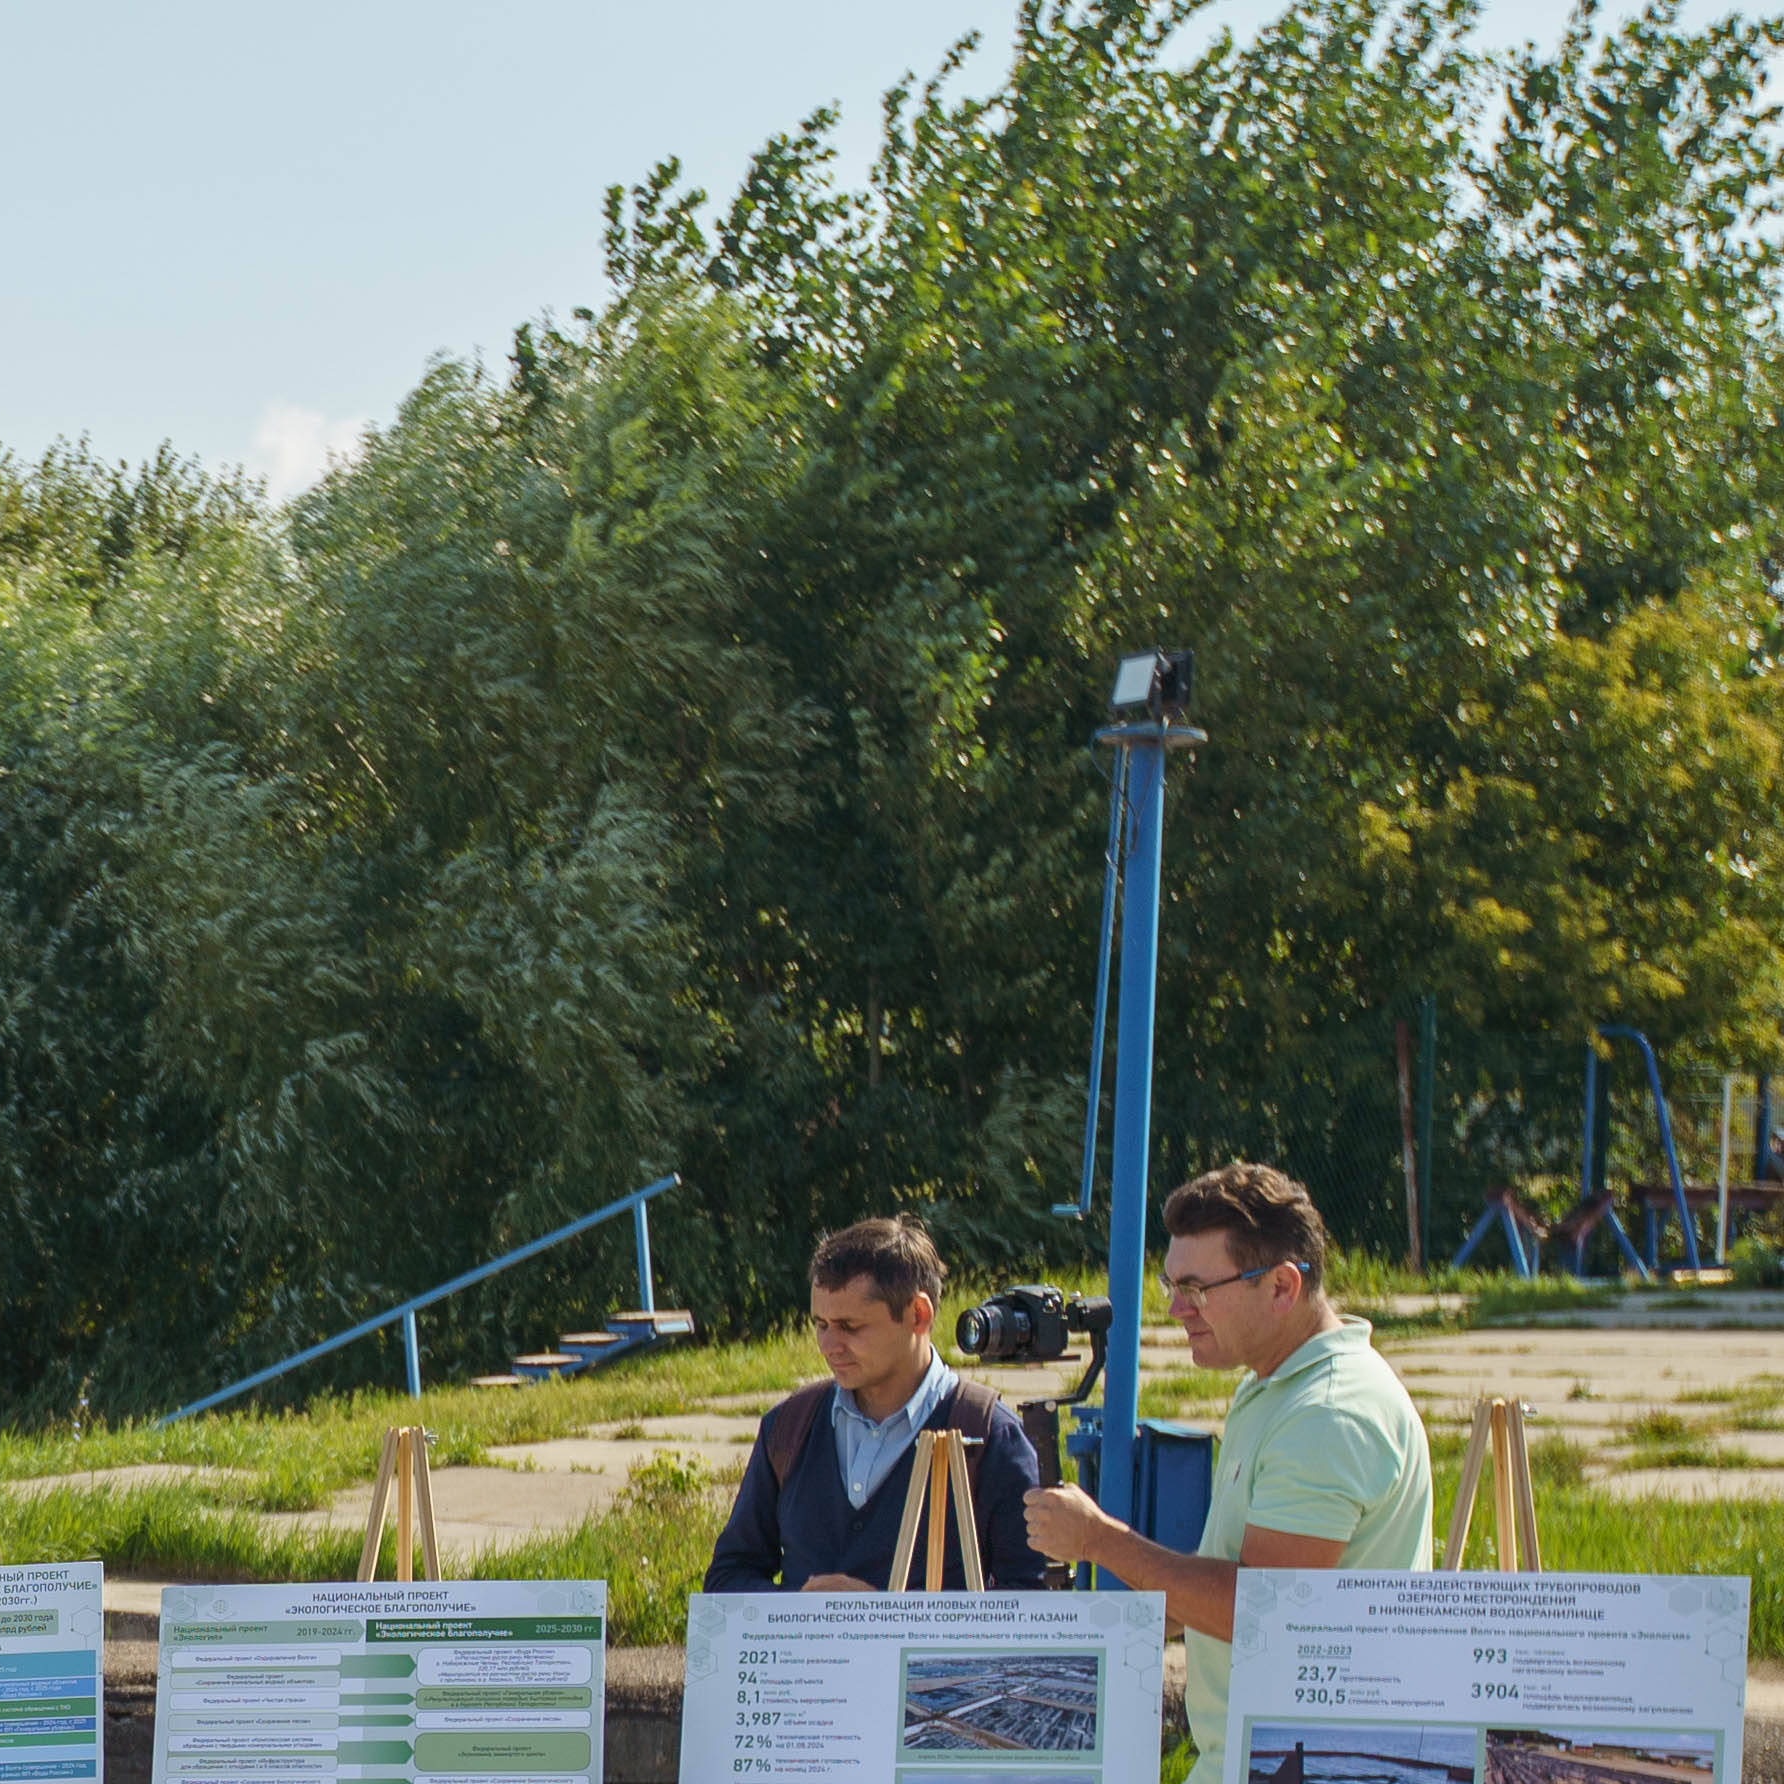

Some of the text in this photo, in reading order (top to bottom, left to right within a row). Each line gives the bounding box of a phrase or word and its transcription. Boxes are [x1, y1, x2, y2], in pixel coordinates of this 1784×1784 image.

[27, 1570, 70, 1581] ПРОЕКТ
[3, 1580, 98, 1594] БЛАГОПОЛУЧИЕ»
[1336, 1578, 1641, 1595] ДЕМОНТАЖ БЕЗДЕЙСТВУЮЩИХ ТРУБОПРОВОДОВ
[312, 1591, 450, 1601] НАЦИОНАЛЬНЫЙ ПРОЕКТ
[1397, 1593, 1577, 1606] ОЗЕРНОГО МЕСТОРОЖДЕНИЯ
[285, 1603, 477, 1613] «ЭКОЛОГИЧЕСКОЕ БЛАГОПОЛУЧИЕ»
[825, 1598, 1020, 1611] РЕКУЛЬТИВАЦИЯ ИЛОВЫХ ПОЛЕЙ
[0, 1616, 12, 1625] до
[13, 1614, 33, 1623] 2030
[34, 1614, 54, 1623] года
[767, 1612, 1079, 1623] БИОЛОГИЧЕСКИХ ОЧИСТНЫХ СООРУЖЕНИЙ Г. КАЗАНИ
[1368, 1606, 1605, 1622] В НИЖНЕКАМСКОМ ВОДОХРАНИЛИЩЕ
[18, 1623, 47, 1634] рублей
[173, 1624, 268, 1634] Национальный проект
[375, 1621, 473, 1630] Национальный проект
[535, 1624, 583, 1634] 2025-2030
[173, 1633, 224, 1642] «Экология»
[296, 1627, 343, 1637] 2019-2024
[375, 1629, 513, 1639] «Экологическое благополучие»
[741, 1631, 1105, 1642] Федеральный проект «Оздоровление Волги» национального проекта «Экология»
[1285, 1623, 1691, 1642] Федеральный проект «Оздоровление Волги» национального проекта «Экология»
[1296, 1645, 1353, 1656] 2022-2023
[1472, 1648, 1508, 1664] 993
[738, 1650, 777, 1665] 2021
[737, 1671, 758, 1686] 94
[1297, 1665, 1338, 1683] 23,7
[794, 1677, 824, 1686] объекта
[737, 1690, 761, 1706] 8,1
[1295, 1688, 1346, 1707] 930,5
[735, 1711, 782, 1728] 3,987
[734, 1734, 773, 1749] 72 %
[733, 1758, 772, 1773] 87 %
[808, 1765, 826, 1773] 2024
